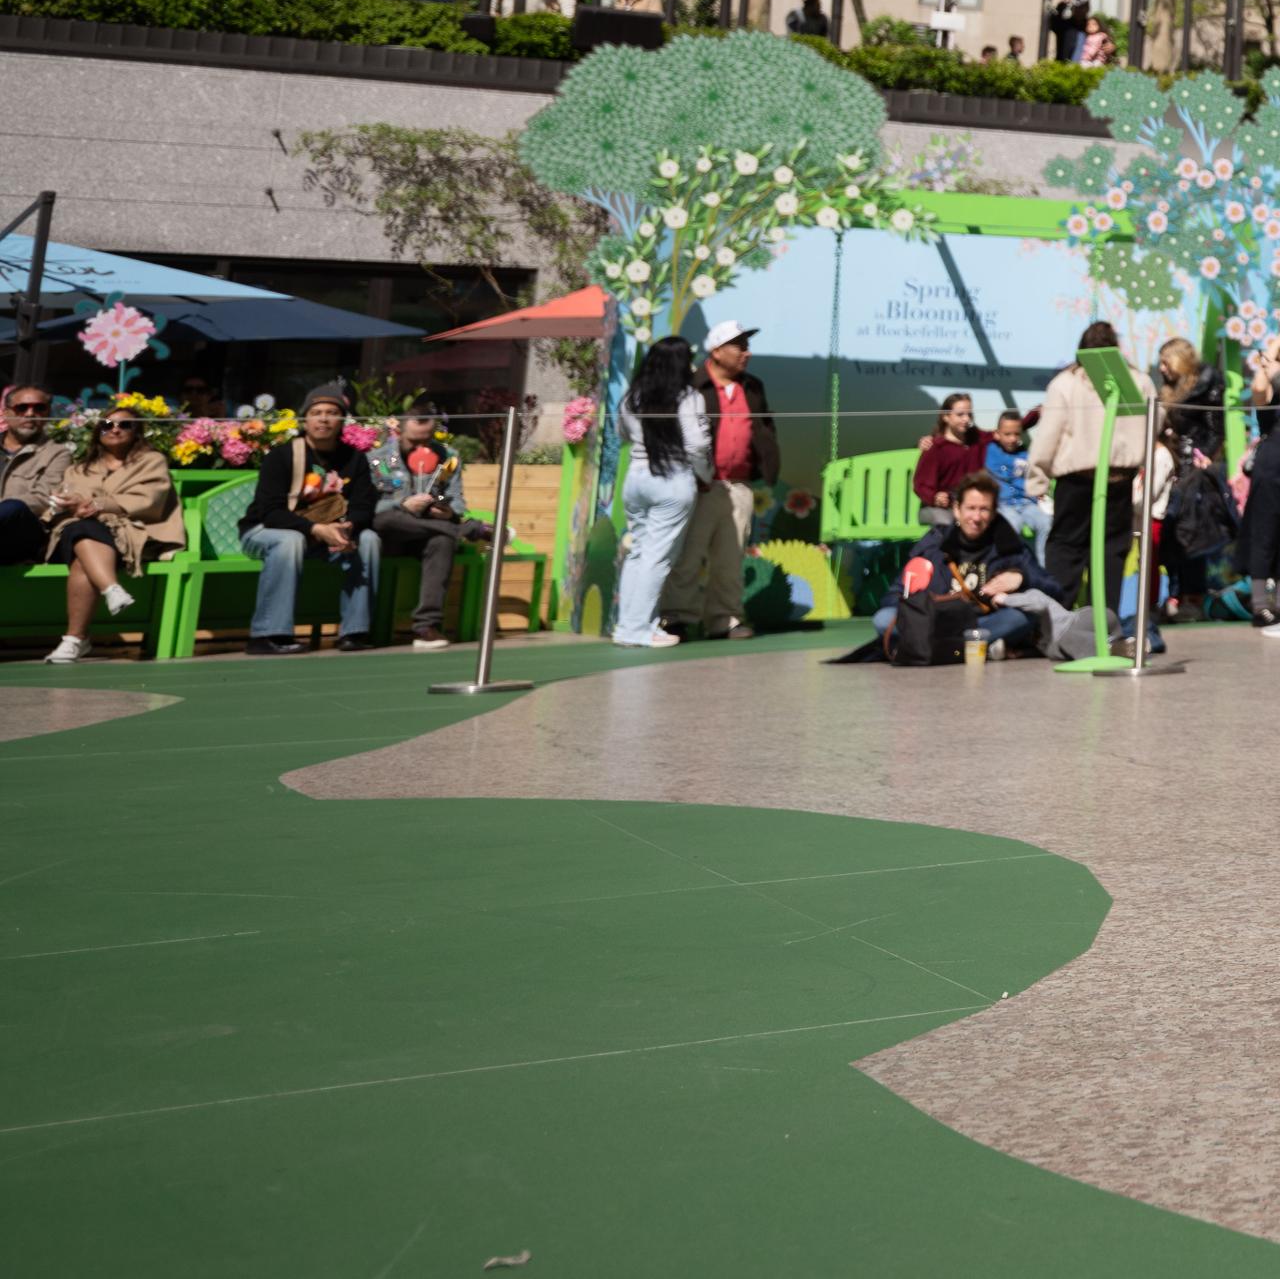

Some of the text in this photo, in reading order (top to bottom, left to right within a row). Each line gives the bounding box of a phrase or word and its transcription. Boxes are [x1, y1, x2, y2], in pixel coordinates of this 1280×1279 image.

[903, 277, 981, 304] Spring
[886, 299, 999, 328] Blooming
[856, 325, 870, 336] at
[875, 324, 959, 339] Rockefeller
